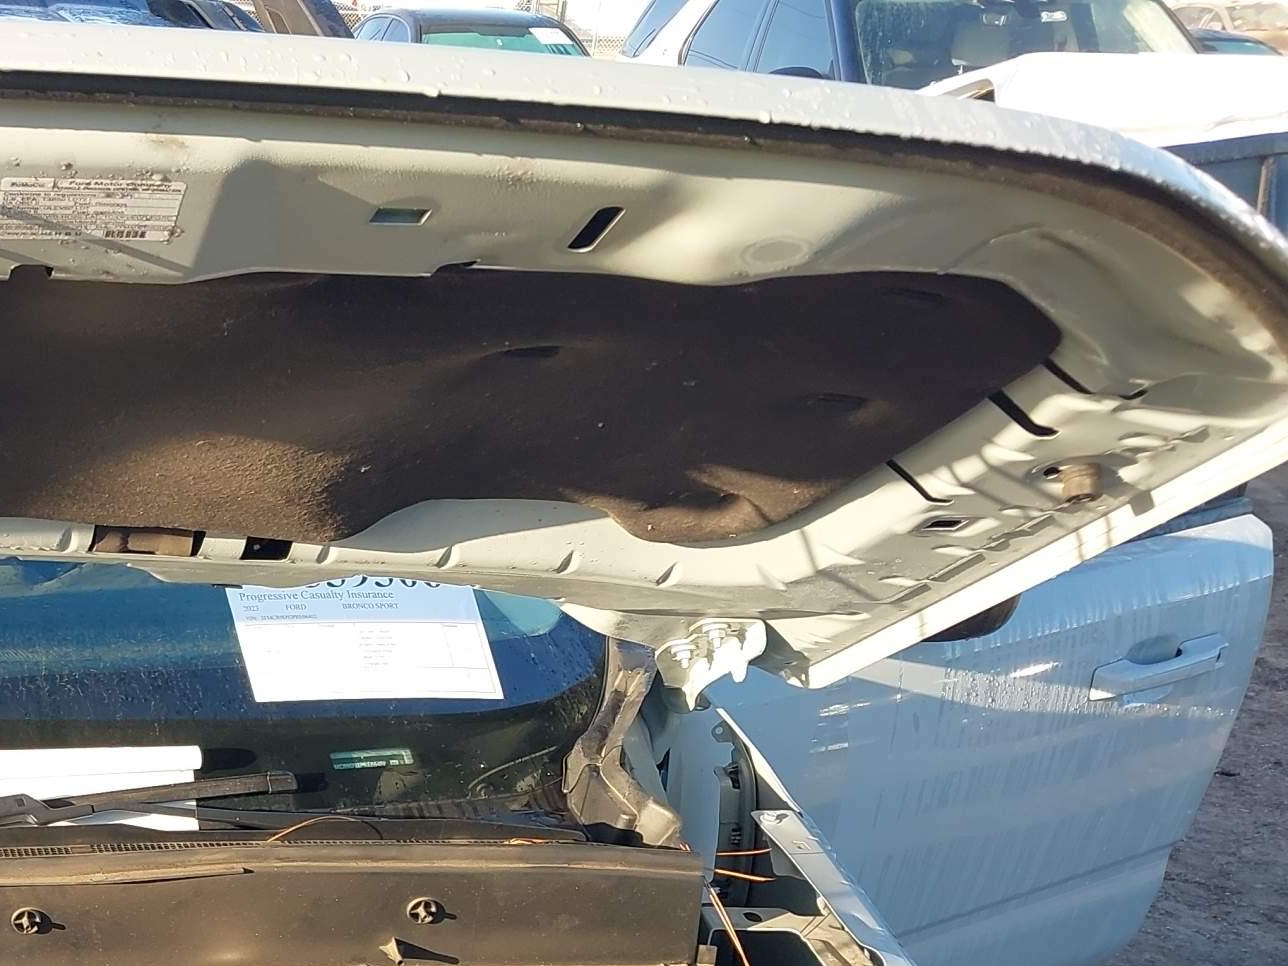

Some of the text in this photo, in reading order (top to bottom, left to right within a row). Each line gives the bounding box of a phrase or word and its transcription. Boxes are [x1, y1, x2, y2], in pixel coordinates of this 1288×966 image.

[239, 589, 394, 602] Progressive Casualty Insurance
